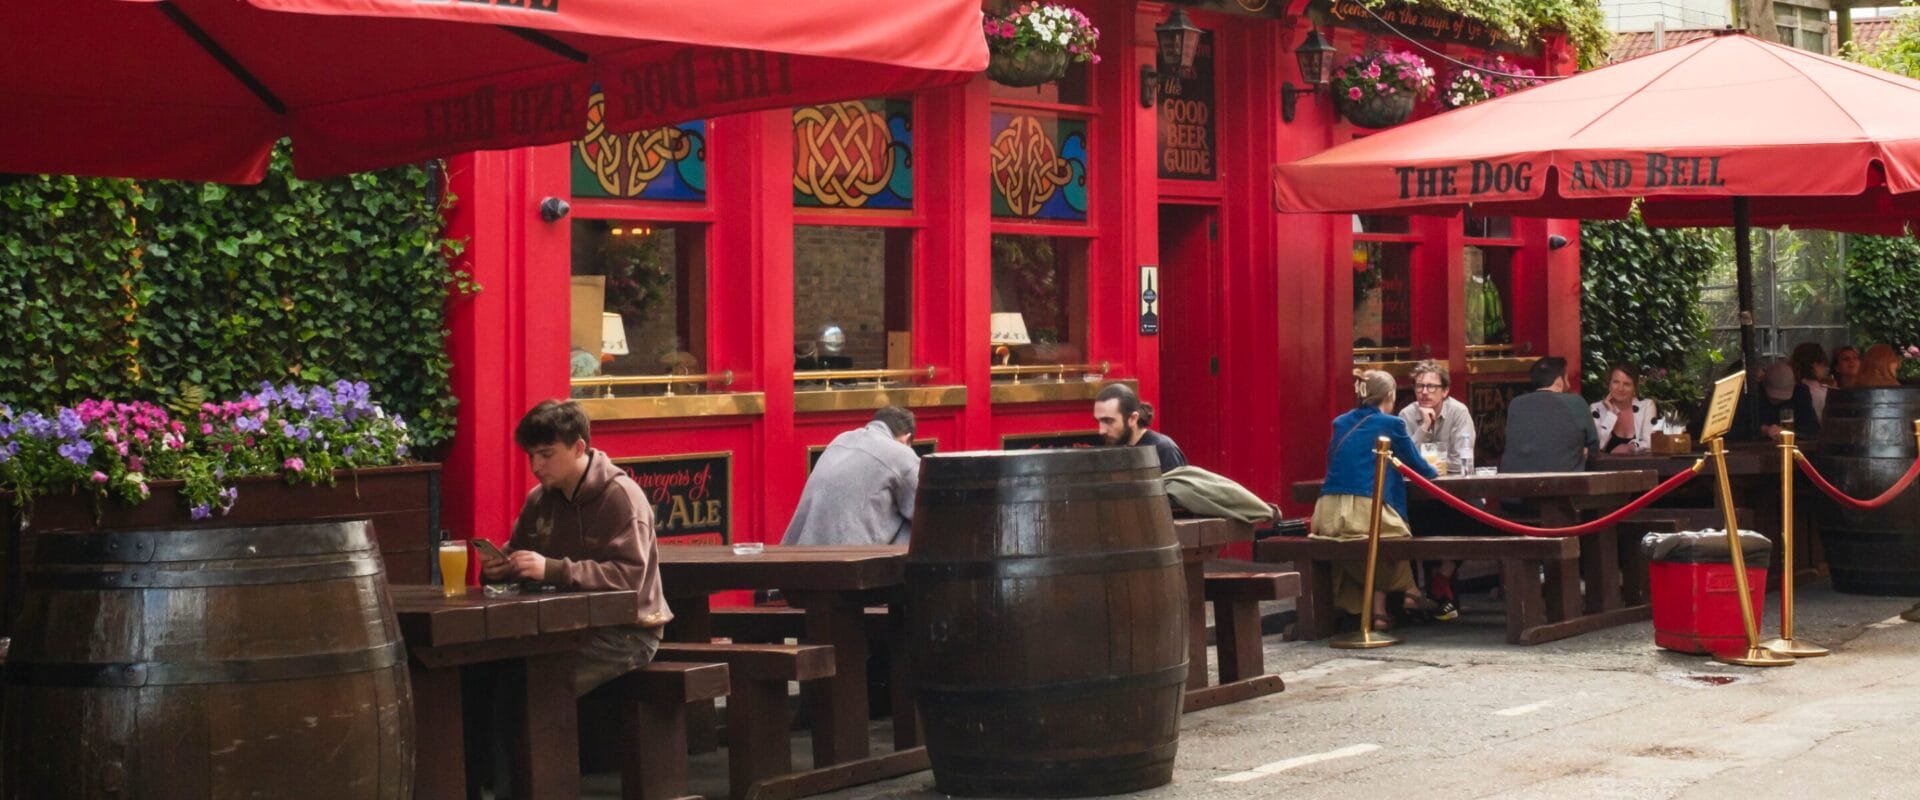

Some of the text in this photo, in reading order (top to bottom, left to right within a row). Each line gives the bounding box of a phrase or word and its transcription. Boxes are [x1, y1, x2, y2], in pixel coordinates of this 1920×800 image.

[1400, 9, 1418, 26] the
[1453, 15, 1464, 39] of
[1164, 98, 1208, 125] GOOD
[1167, 123, 1208, 149] BEER
[1164, 148, 1211, 175] GUIDE
[1394, 152, 1725, 199] THE DOG AND BELL
[689, 463, 711, 500] of
[667, 495, 721, 529] ALE
